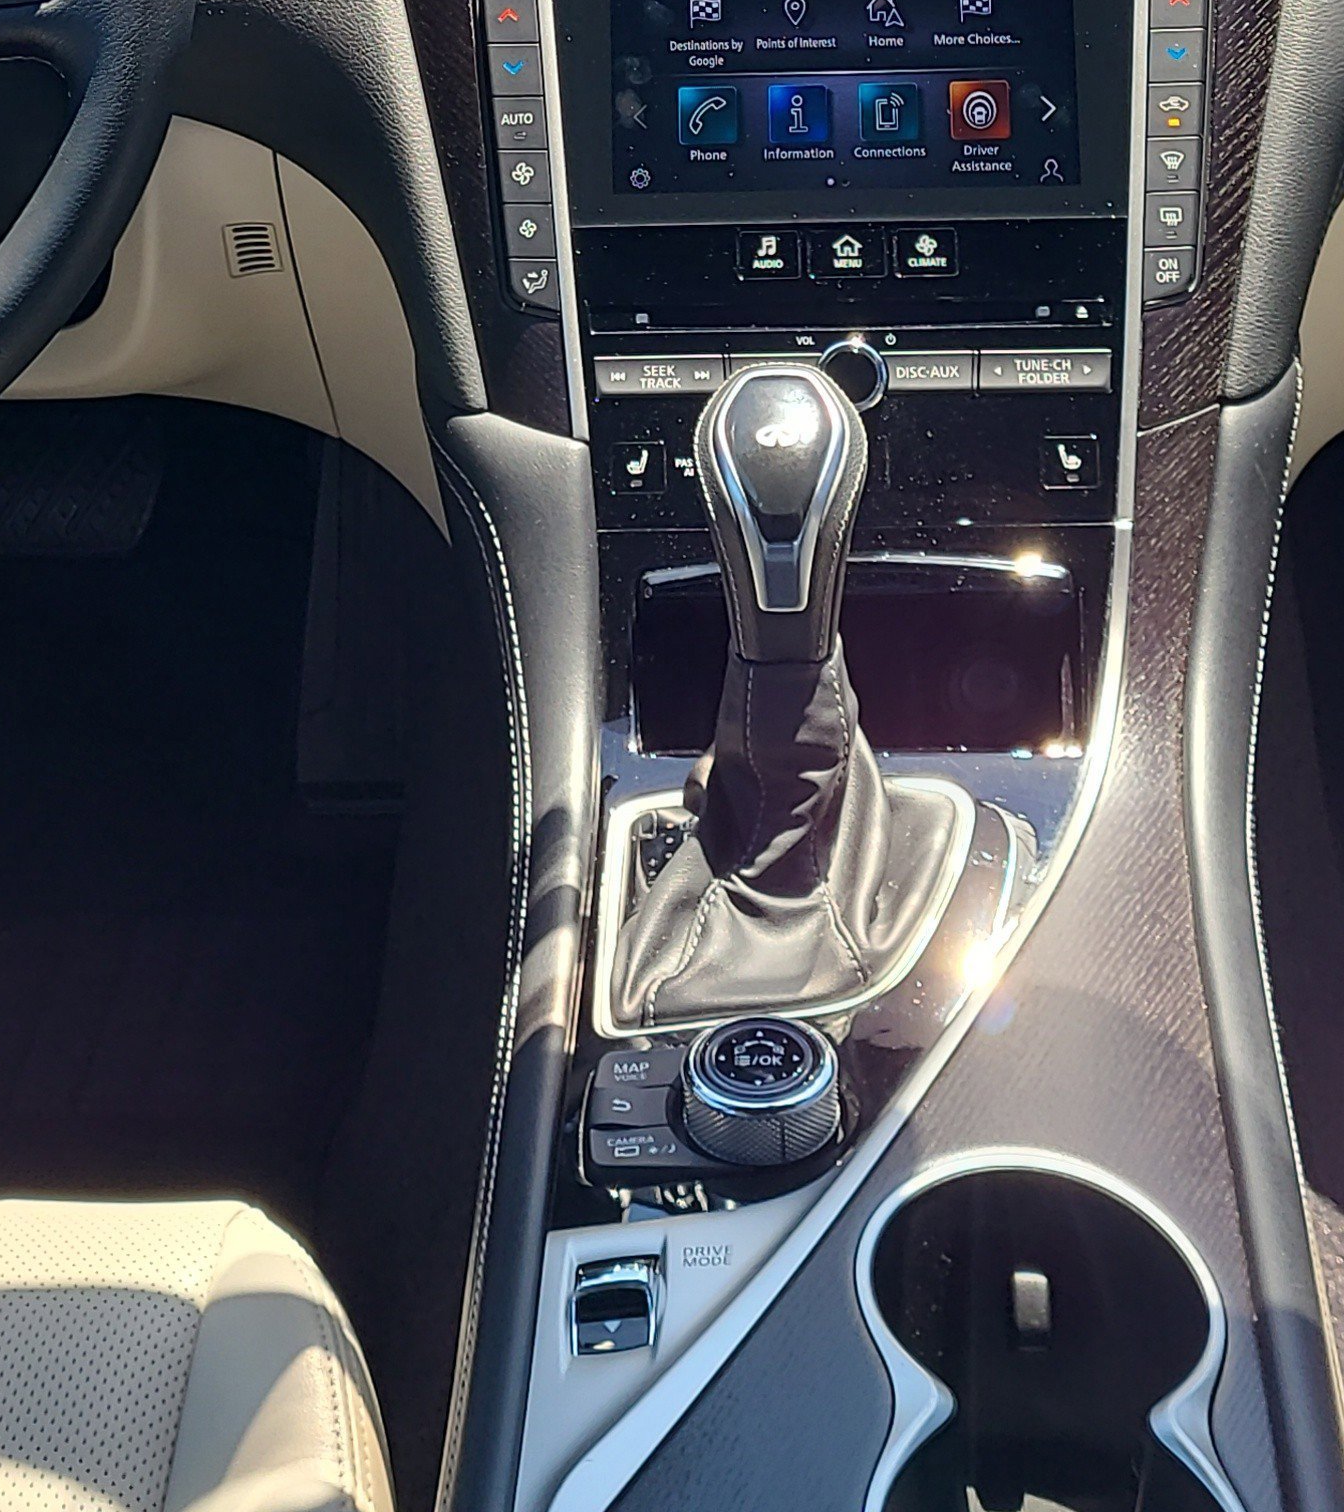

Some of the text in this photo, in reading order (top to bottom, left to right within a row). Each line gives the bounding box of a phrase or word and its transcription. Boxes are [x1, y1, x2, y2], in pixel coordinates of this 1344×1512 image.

[670, 39, 744, 53] Destinations by
[756, 37, 837, 49] Points of Interest
[869, 36, 904, 47] Home
[934, 34, 965, 46] More
[689, 55, 724, 68] Google
[501, 113, 533, 126] AUTO
[690, 149, 728, 161] Phone
[764, 147, 834, 160] Information
[854, 146, 926, 158] Connections
[963, 144, 999, 156] Driver
[952, 160, 1012, 172] Assistance
[753, 259, 784, 269] AUDIO
[833, 258, 862, 268] MENU
[908, 257, 948, 267] CLIMATE
[1158, 258, 1179, 271] ON
[1156, 271, 1181, 284] OFF
[796, 336, 815, 346] VOL
[643, 365, 676, 377] SEEK
[639, 377, 682, 389] TRACK
[1018, 373, 1070, 384] FOLDER
[614, 1062, 650, 1074] MAP
[607, 1135, 654, 1147] CAMERA
[683, 1245, 733, 1257] DRIVE
[683, 1256, 731, 1268] MODE
